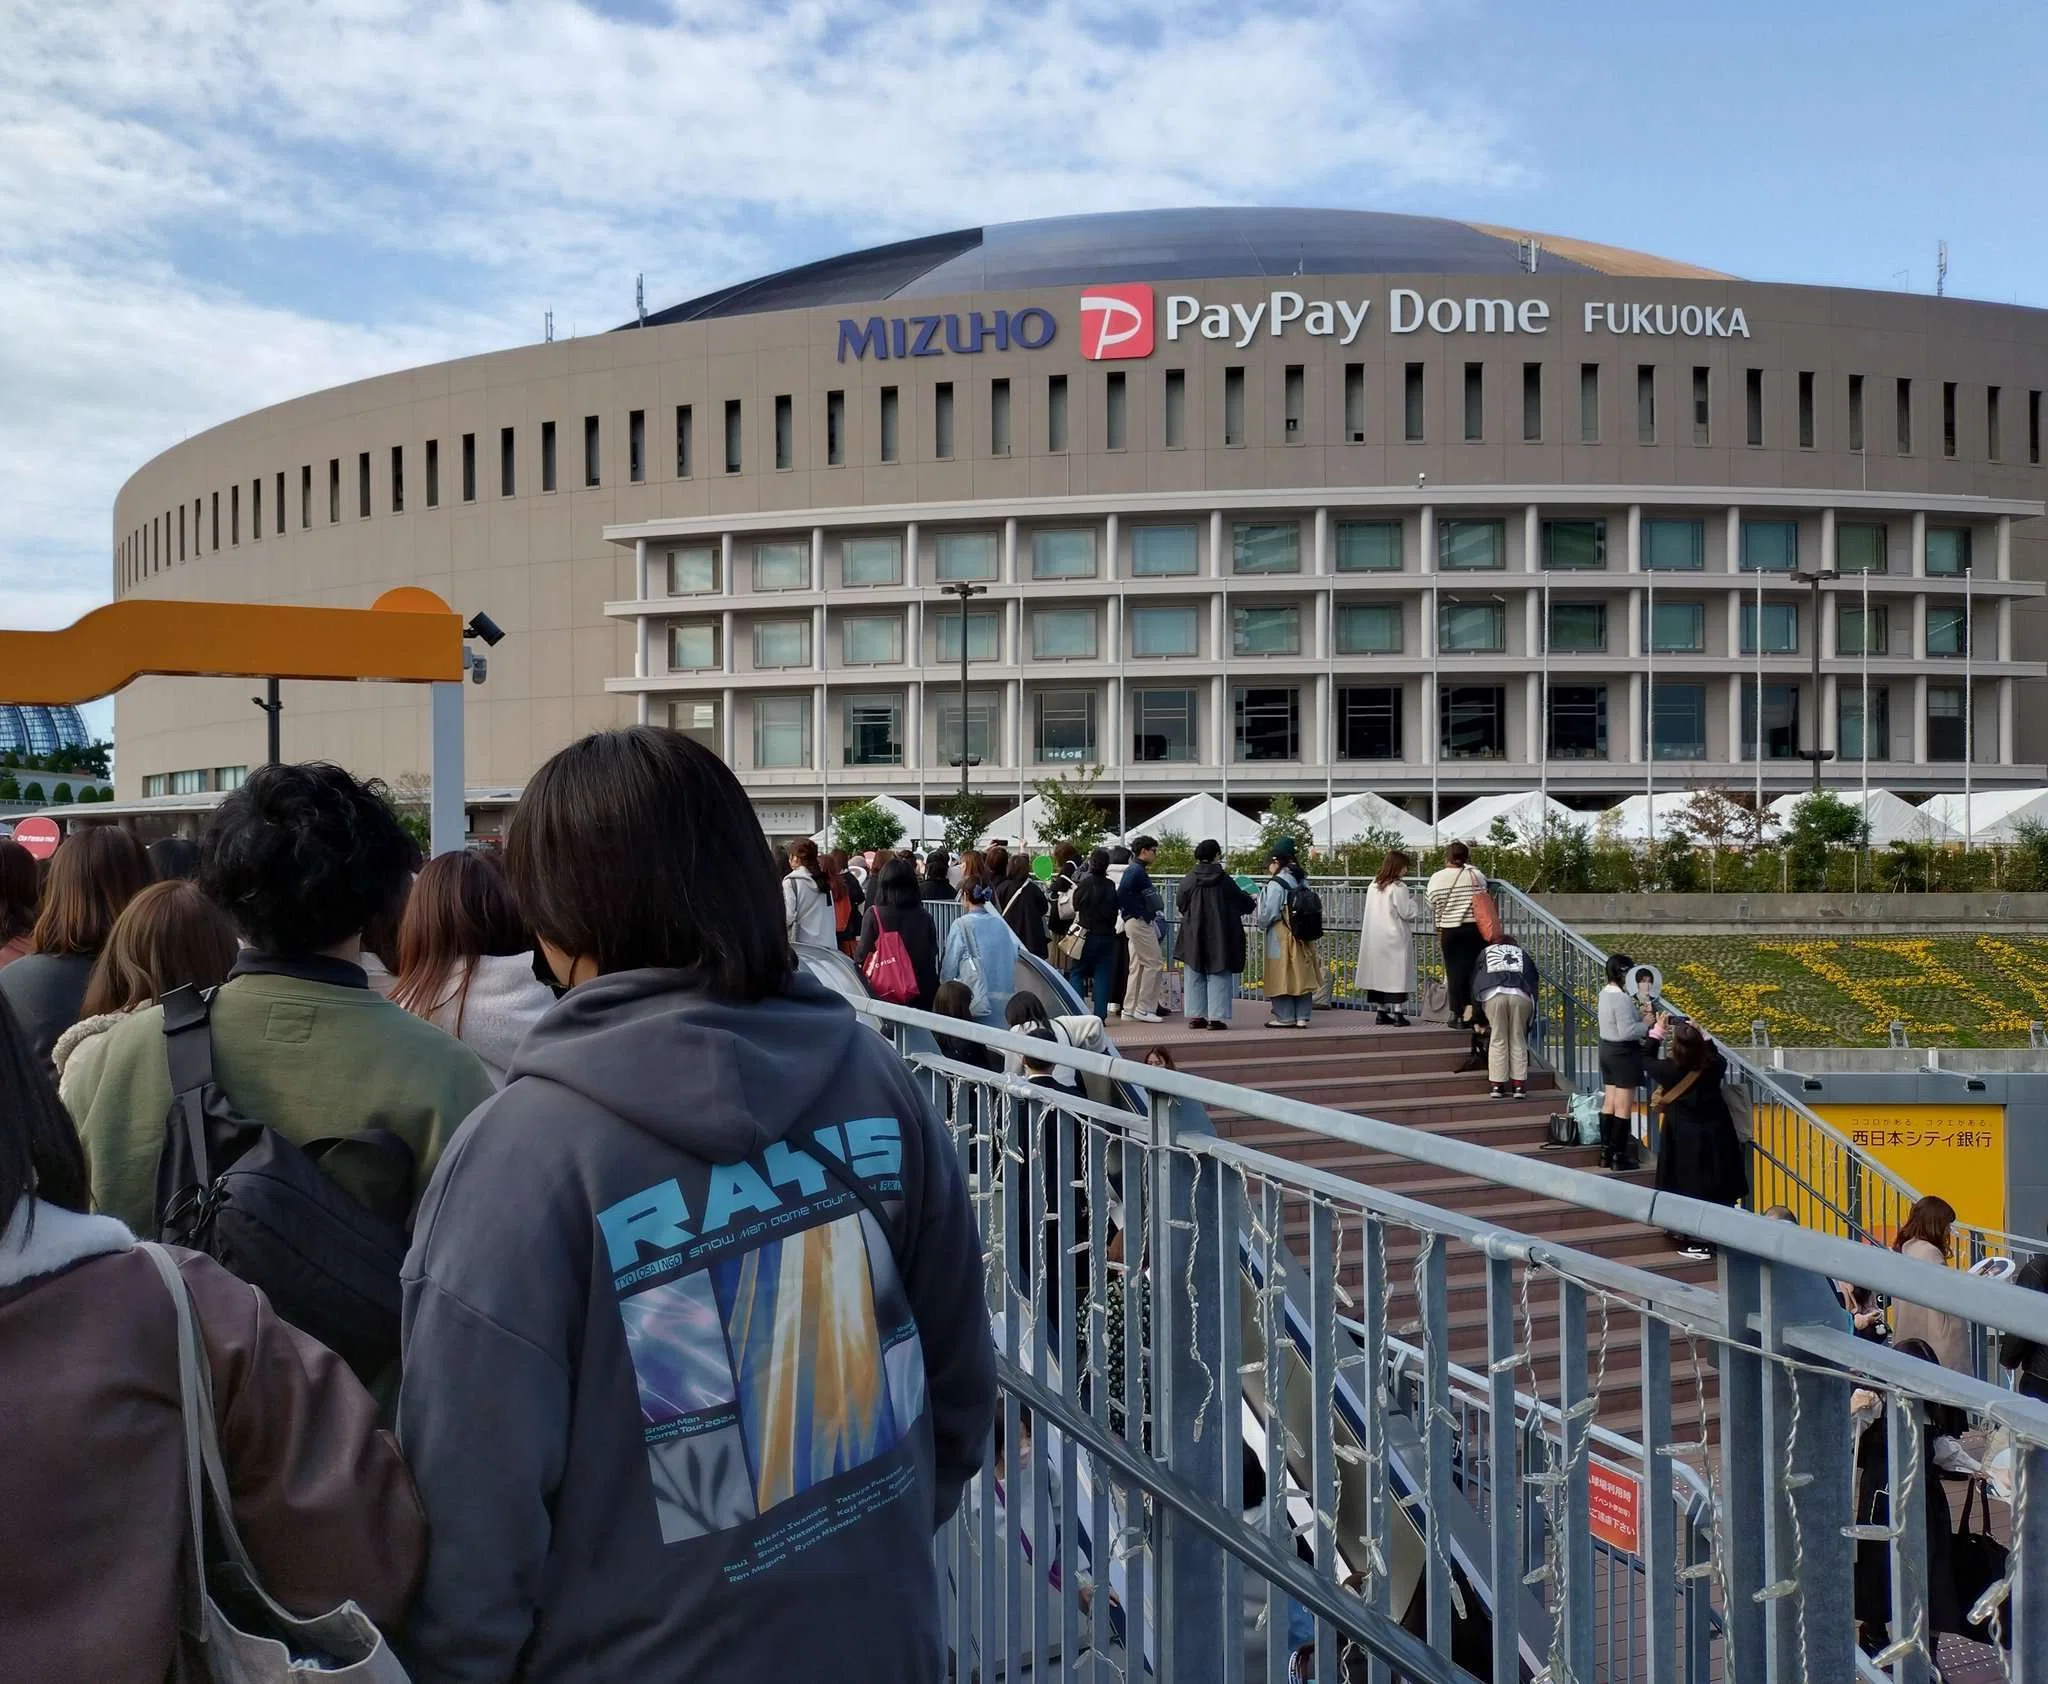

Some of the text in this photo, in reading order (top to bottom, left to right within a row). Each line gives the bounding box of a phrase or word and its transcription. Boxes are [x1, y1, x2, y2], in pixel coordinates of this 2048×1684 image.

[837, 307, 1057, 363] MIZUHO
[1166, 290, 1371, 349] PayPay
[1389, 288, 1551, 334] Dome
[1583, 301, 1751, 339] FUKUOKA
[1852, 1129, 1992, 1148] 西日本シティ銀行
[596, 1117, 902, 1273] RAYS
